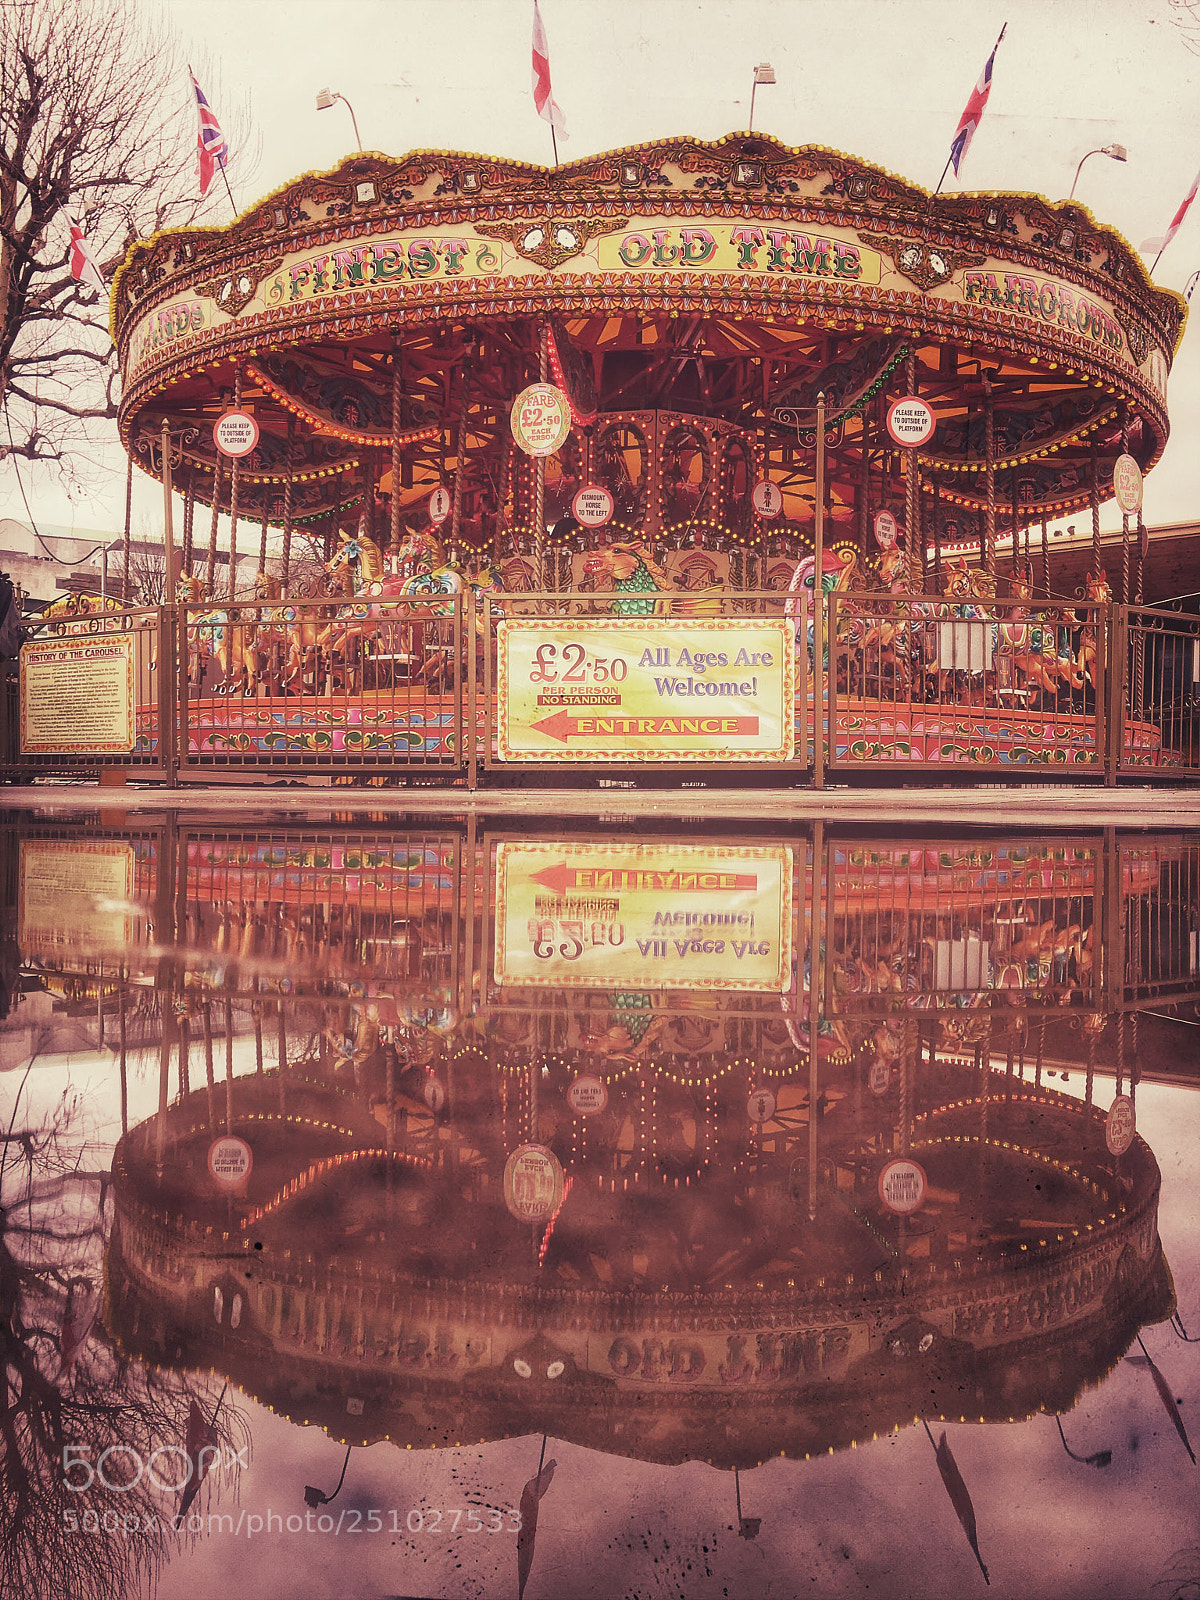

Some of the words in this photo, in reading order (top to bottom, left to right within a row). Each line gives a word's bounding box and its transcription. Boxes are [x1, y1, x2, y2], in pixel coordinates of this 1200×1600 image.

[618, 227, 719, 268] OLD
[729, 225, 863, 280] TIME
[289, 238, 471, 301] FINEST
[965, 272, 1124, 353] FAIRGROUND
[527, 394, 556, 408] FARE
[895, 409, 913, 417] PLEASE
[901, 417, 921, 425] OUTSIDE
[527, 433, 556, 442] PERSON
[29, 652, 56, 662] HISTORY
[58, 651, 68, 660] OF
[70, 650, 83, 659] THE
[85, 647, 123, 657] CAROUSEL
[638, 647, 671, 667] All
[678, 647, 728, 673] Ages
[734, 647, 774, 667] Are
[542, 686, 566, 695] PER
[570, 686, 619, 695] PERSON
[653, 676, 758, 697] Welcome!
[542, 696, 560, 704] NO
[562, 696, 617, 704] STANDING
[576, 718, 739, 734] ENTRANCE
